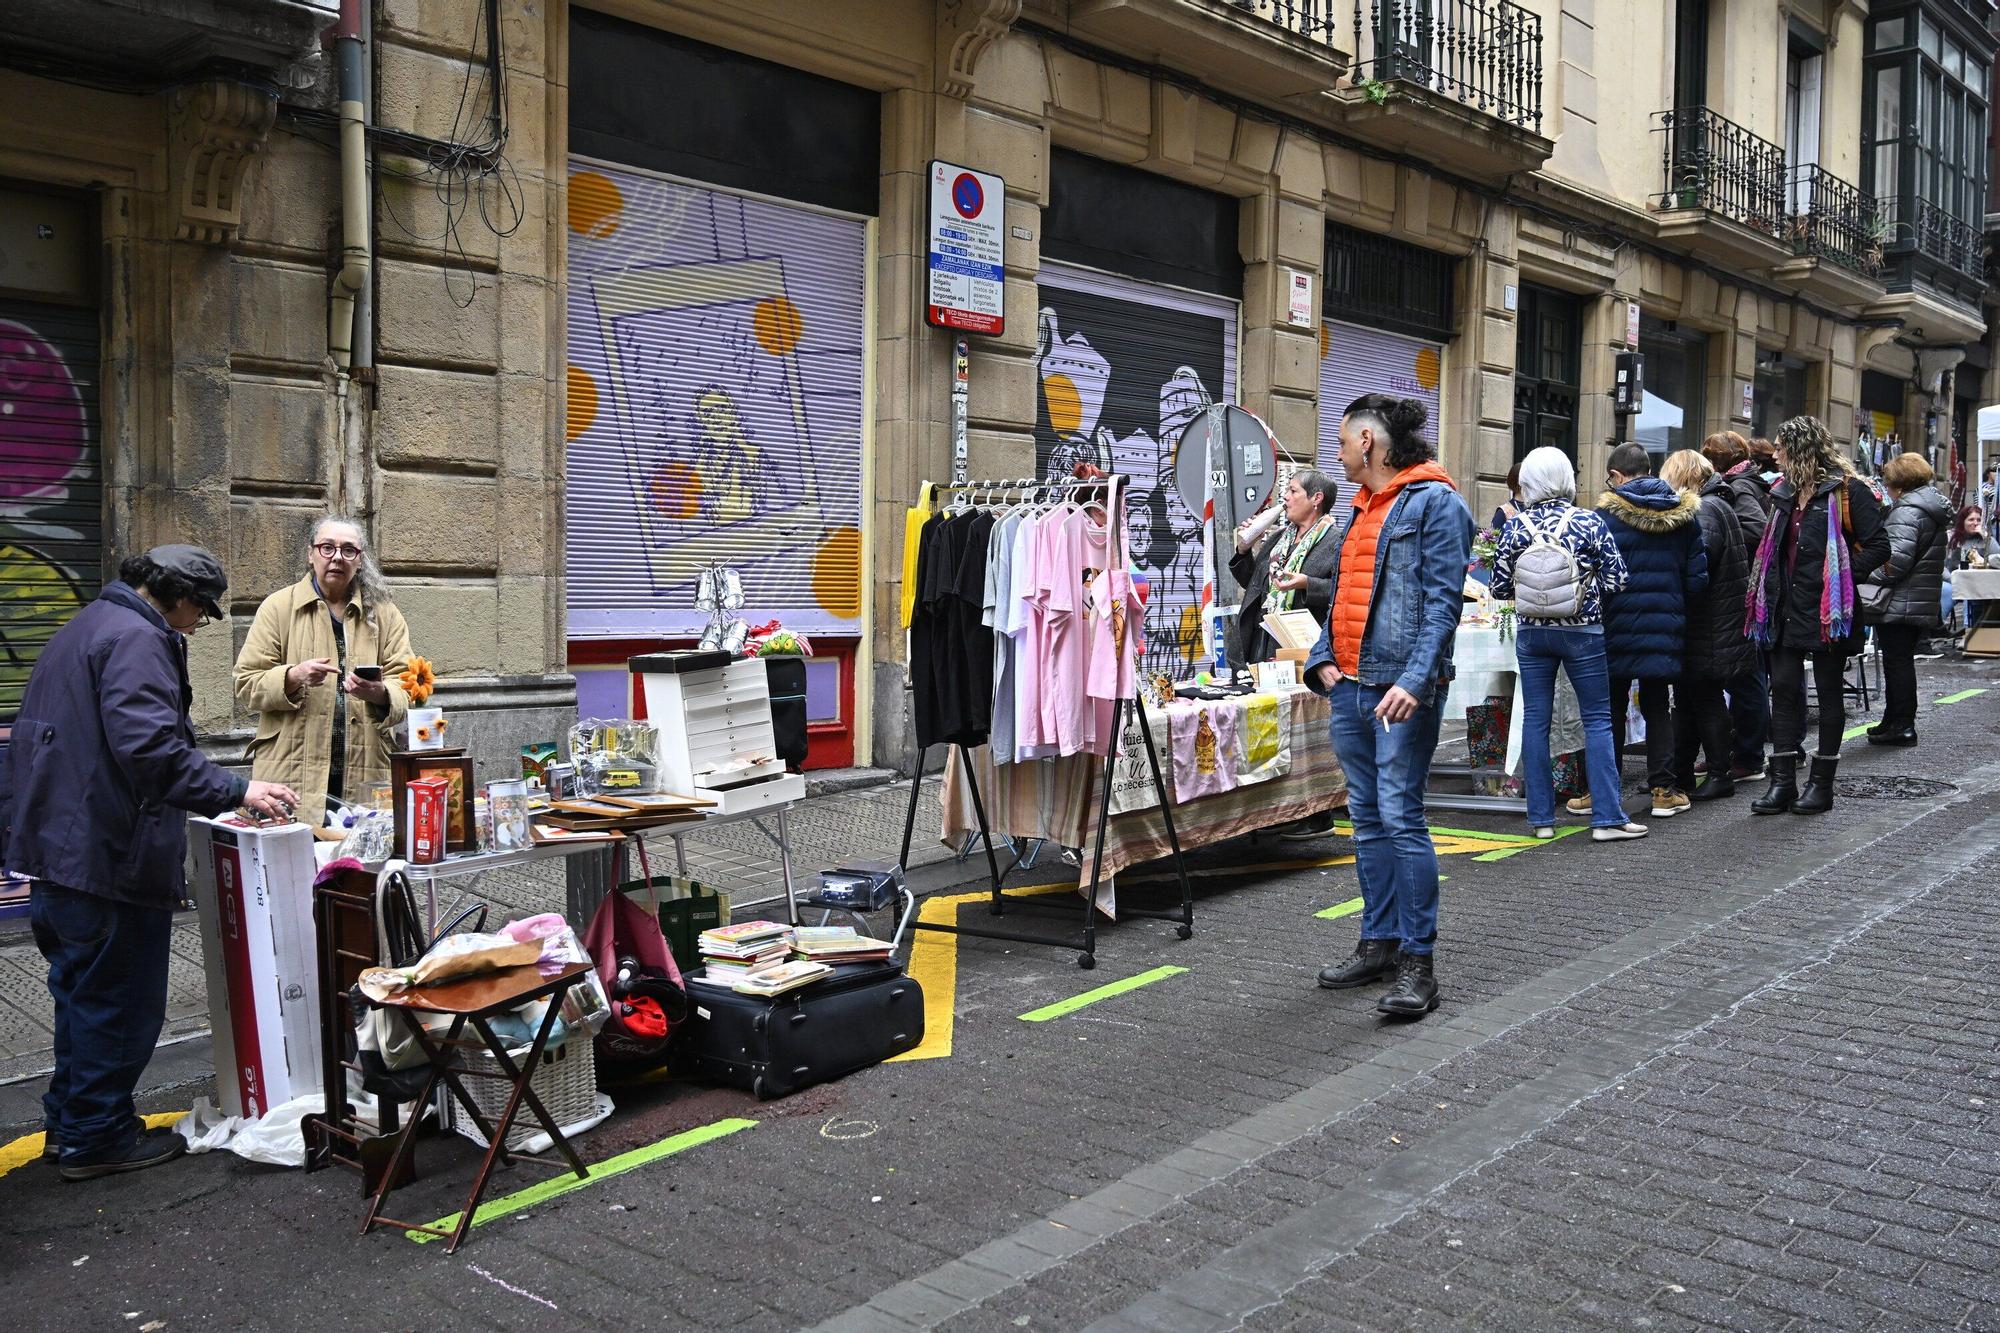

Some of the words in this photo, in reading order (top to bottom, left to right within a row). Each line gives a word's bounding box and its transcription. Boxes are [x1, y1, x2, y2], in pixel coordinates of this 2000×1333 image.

[934, 262, 956, 272] EXCEPTO
[956, 267, 972, 276] CARGA
[975, 271, 998, 280] DESCARGA
[1212, 471, 1226, 486] 90
[226, 893, 239, 940] LED
[244, 1066, 255, 1094] LG
